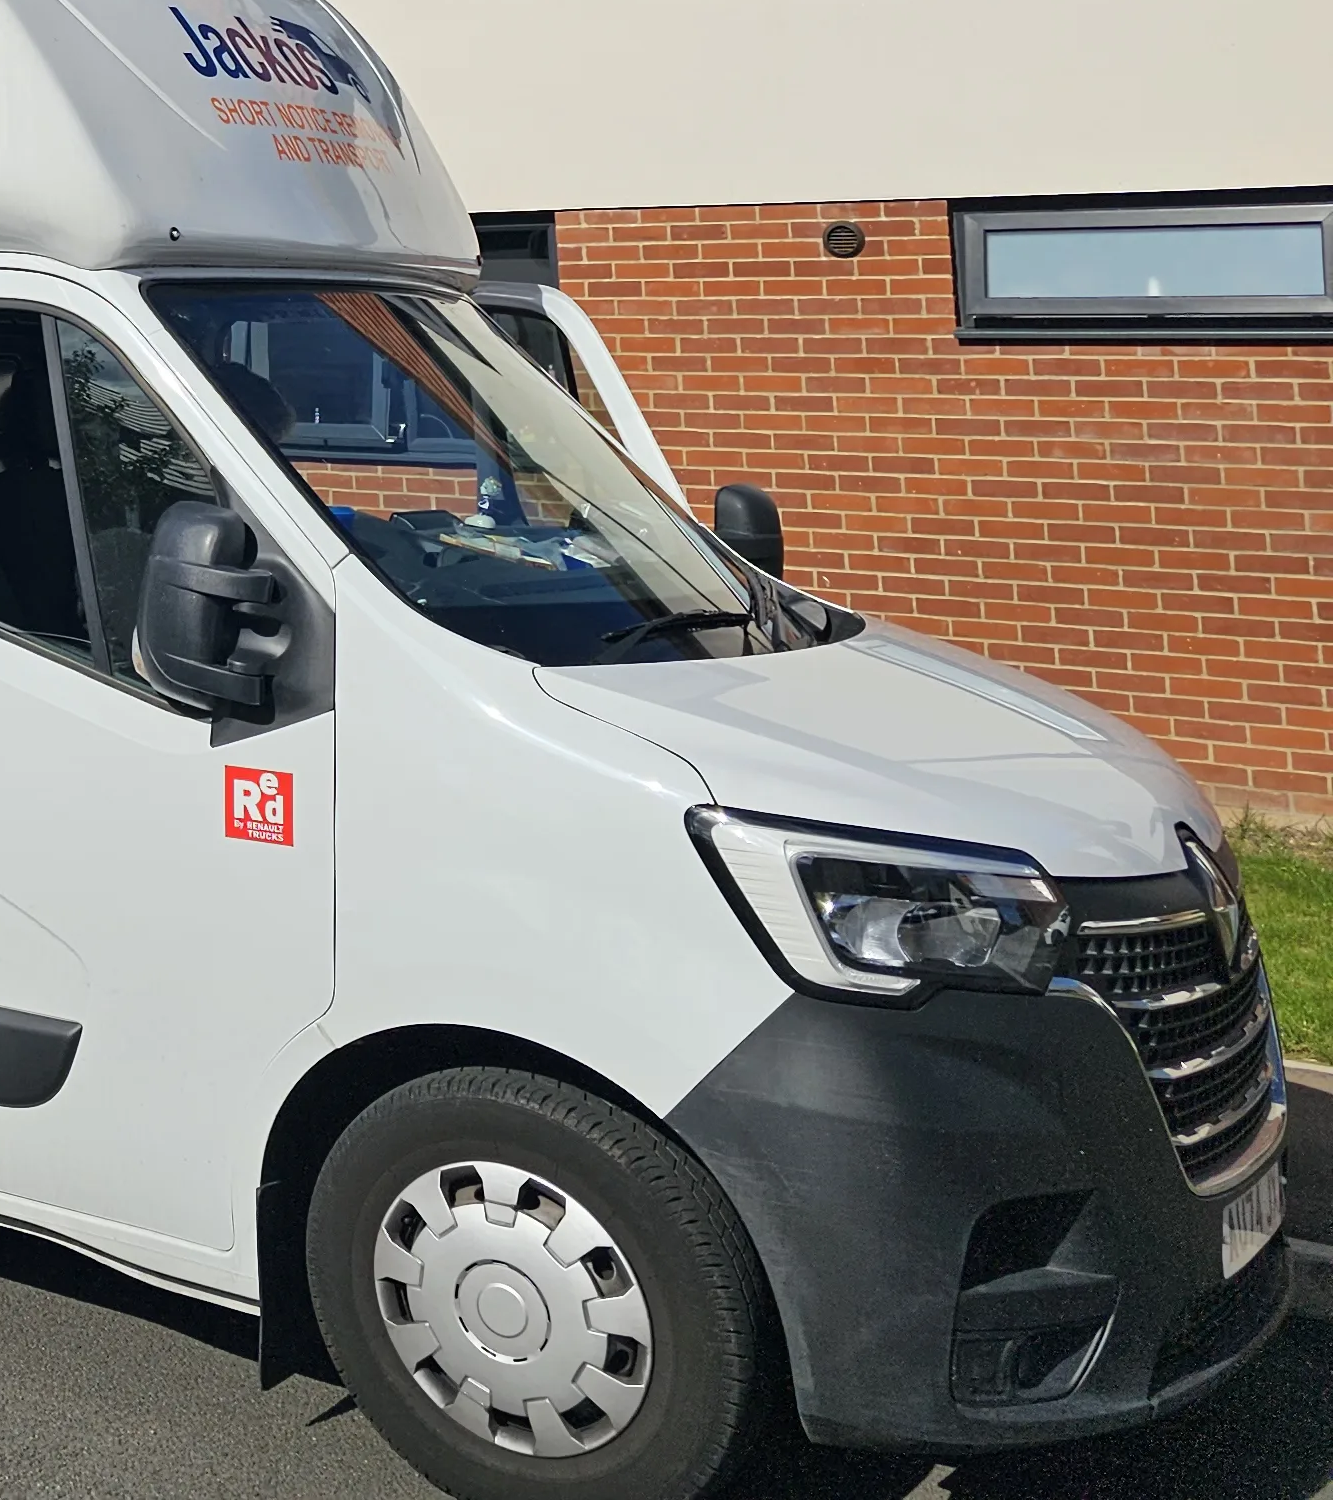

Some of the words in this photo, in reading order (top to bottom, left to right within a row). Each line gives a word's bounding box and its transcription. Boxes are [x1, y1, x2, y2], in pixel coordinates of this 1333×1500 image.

[168, 6, 339, 95] Jackos
[210, 97, 277, 127] SHORT
[277, 102, 338, 135] NOTICE
[272, 133, 312, 163] AND
[247, 821, 284, 833] RENAULT
[247, 829, 284, 842] TRUCKS
